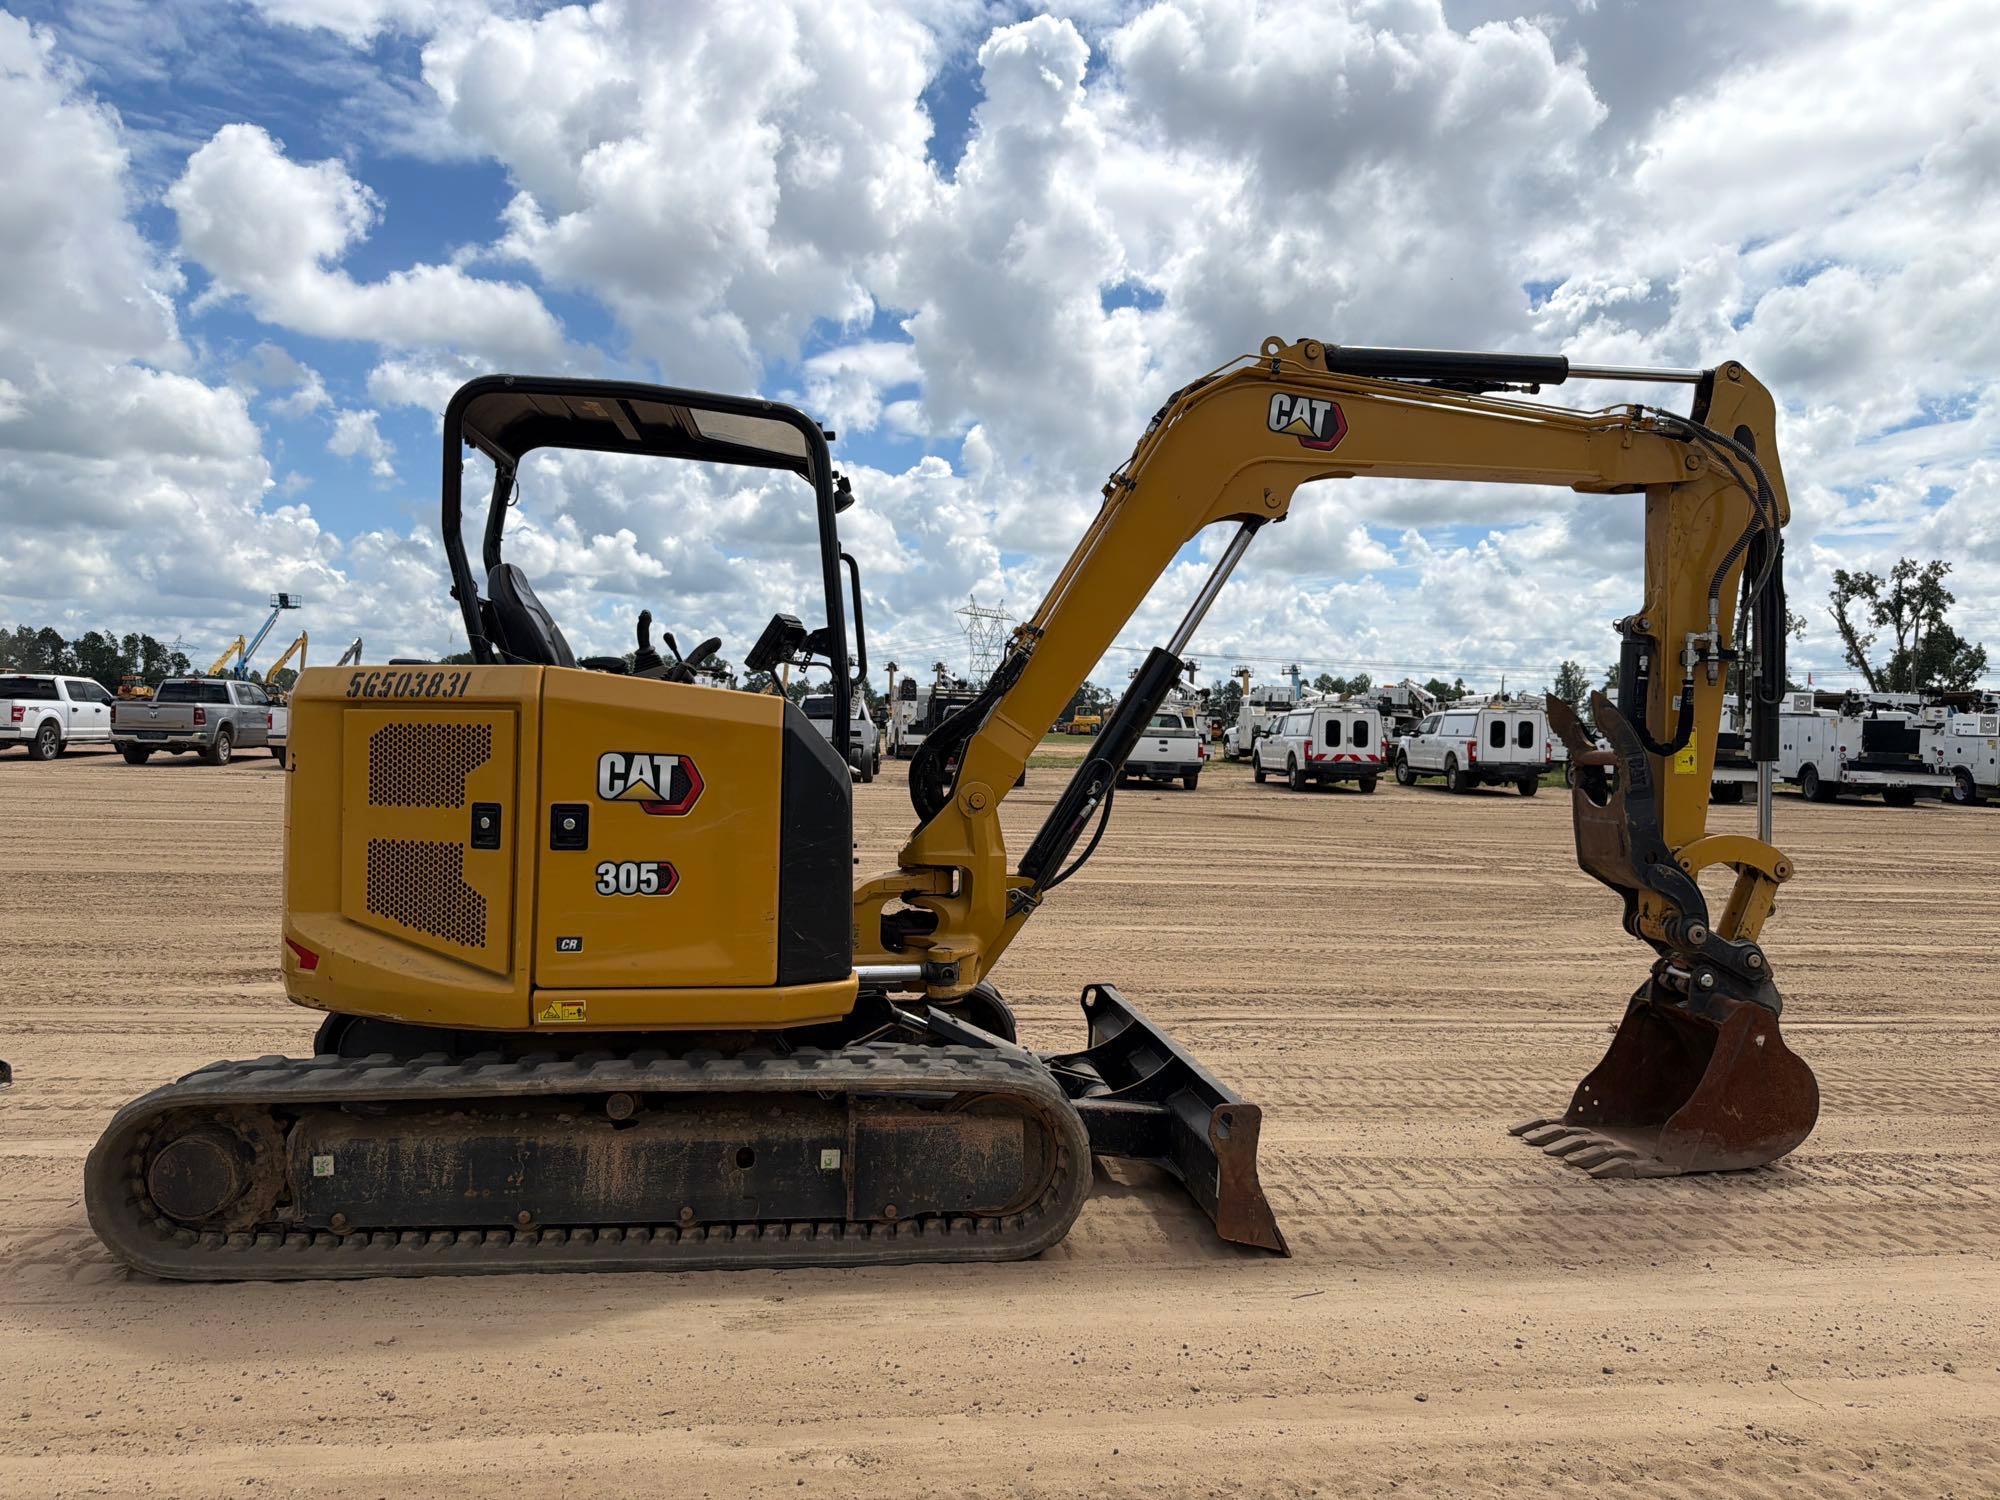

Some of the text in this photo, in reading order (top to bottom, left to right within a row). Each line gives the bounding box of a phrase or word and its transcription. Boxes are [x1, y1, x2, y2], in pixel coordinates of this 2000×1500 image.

[1269, 393, 1331, 438] CAT
[599, 752, 679, 801] CAT
[597, 861, 659, 895] 305
[560, 938, 578, 950] CR
